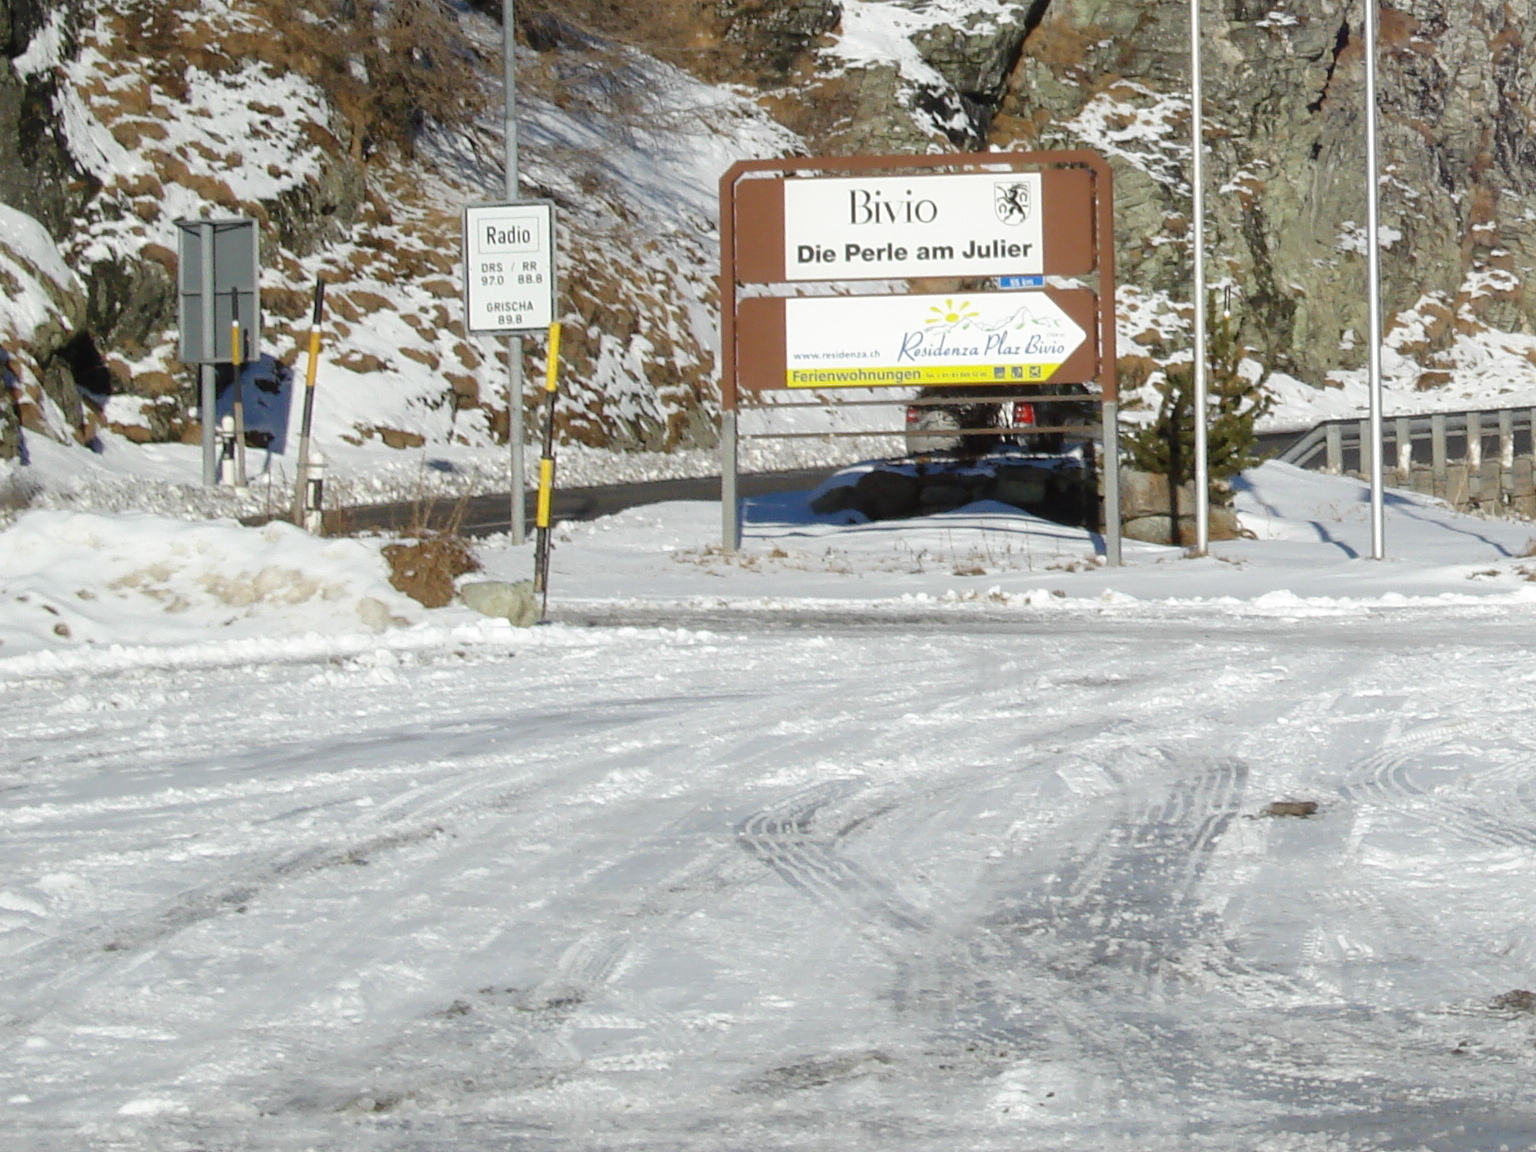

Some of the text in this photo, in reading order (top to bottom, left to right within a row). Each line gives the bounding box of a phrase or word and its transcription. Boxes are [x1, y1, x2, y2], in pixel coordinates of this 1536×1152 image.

[847, 189, 938, 225] Bivio
[486, 225, 531, 245] Radio
[797, 239, 1033, 264] Die Perle am Julier
[481, 262, 503, 273] DRS
[522, 261, 537, 271] RR
[481, 275, 504, 286] 97.0
[486, 301, 534, 312] GRISCHA
[897, 330, 1065, 362] Residenza Plaz Bivio
[793, 349, 881, 361] www.residenza.ch
[792, 368, 921, 384] Ferienwohnungen
